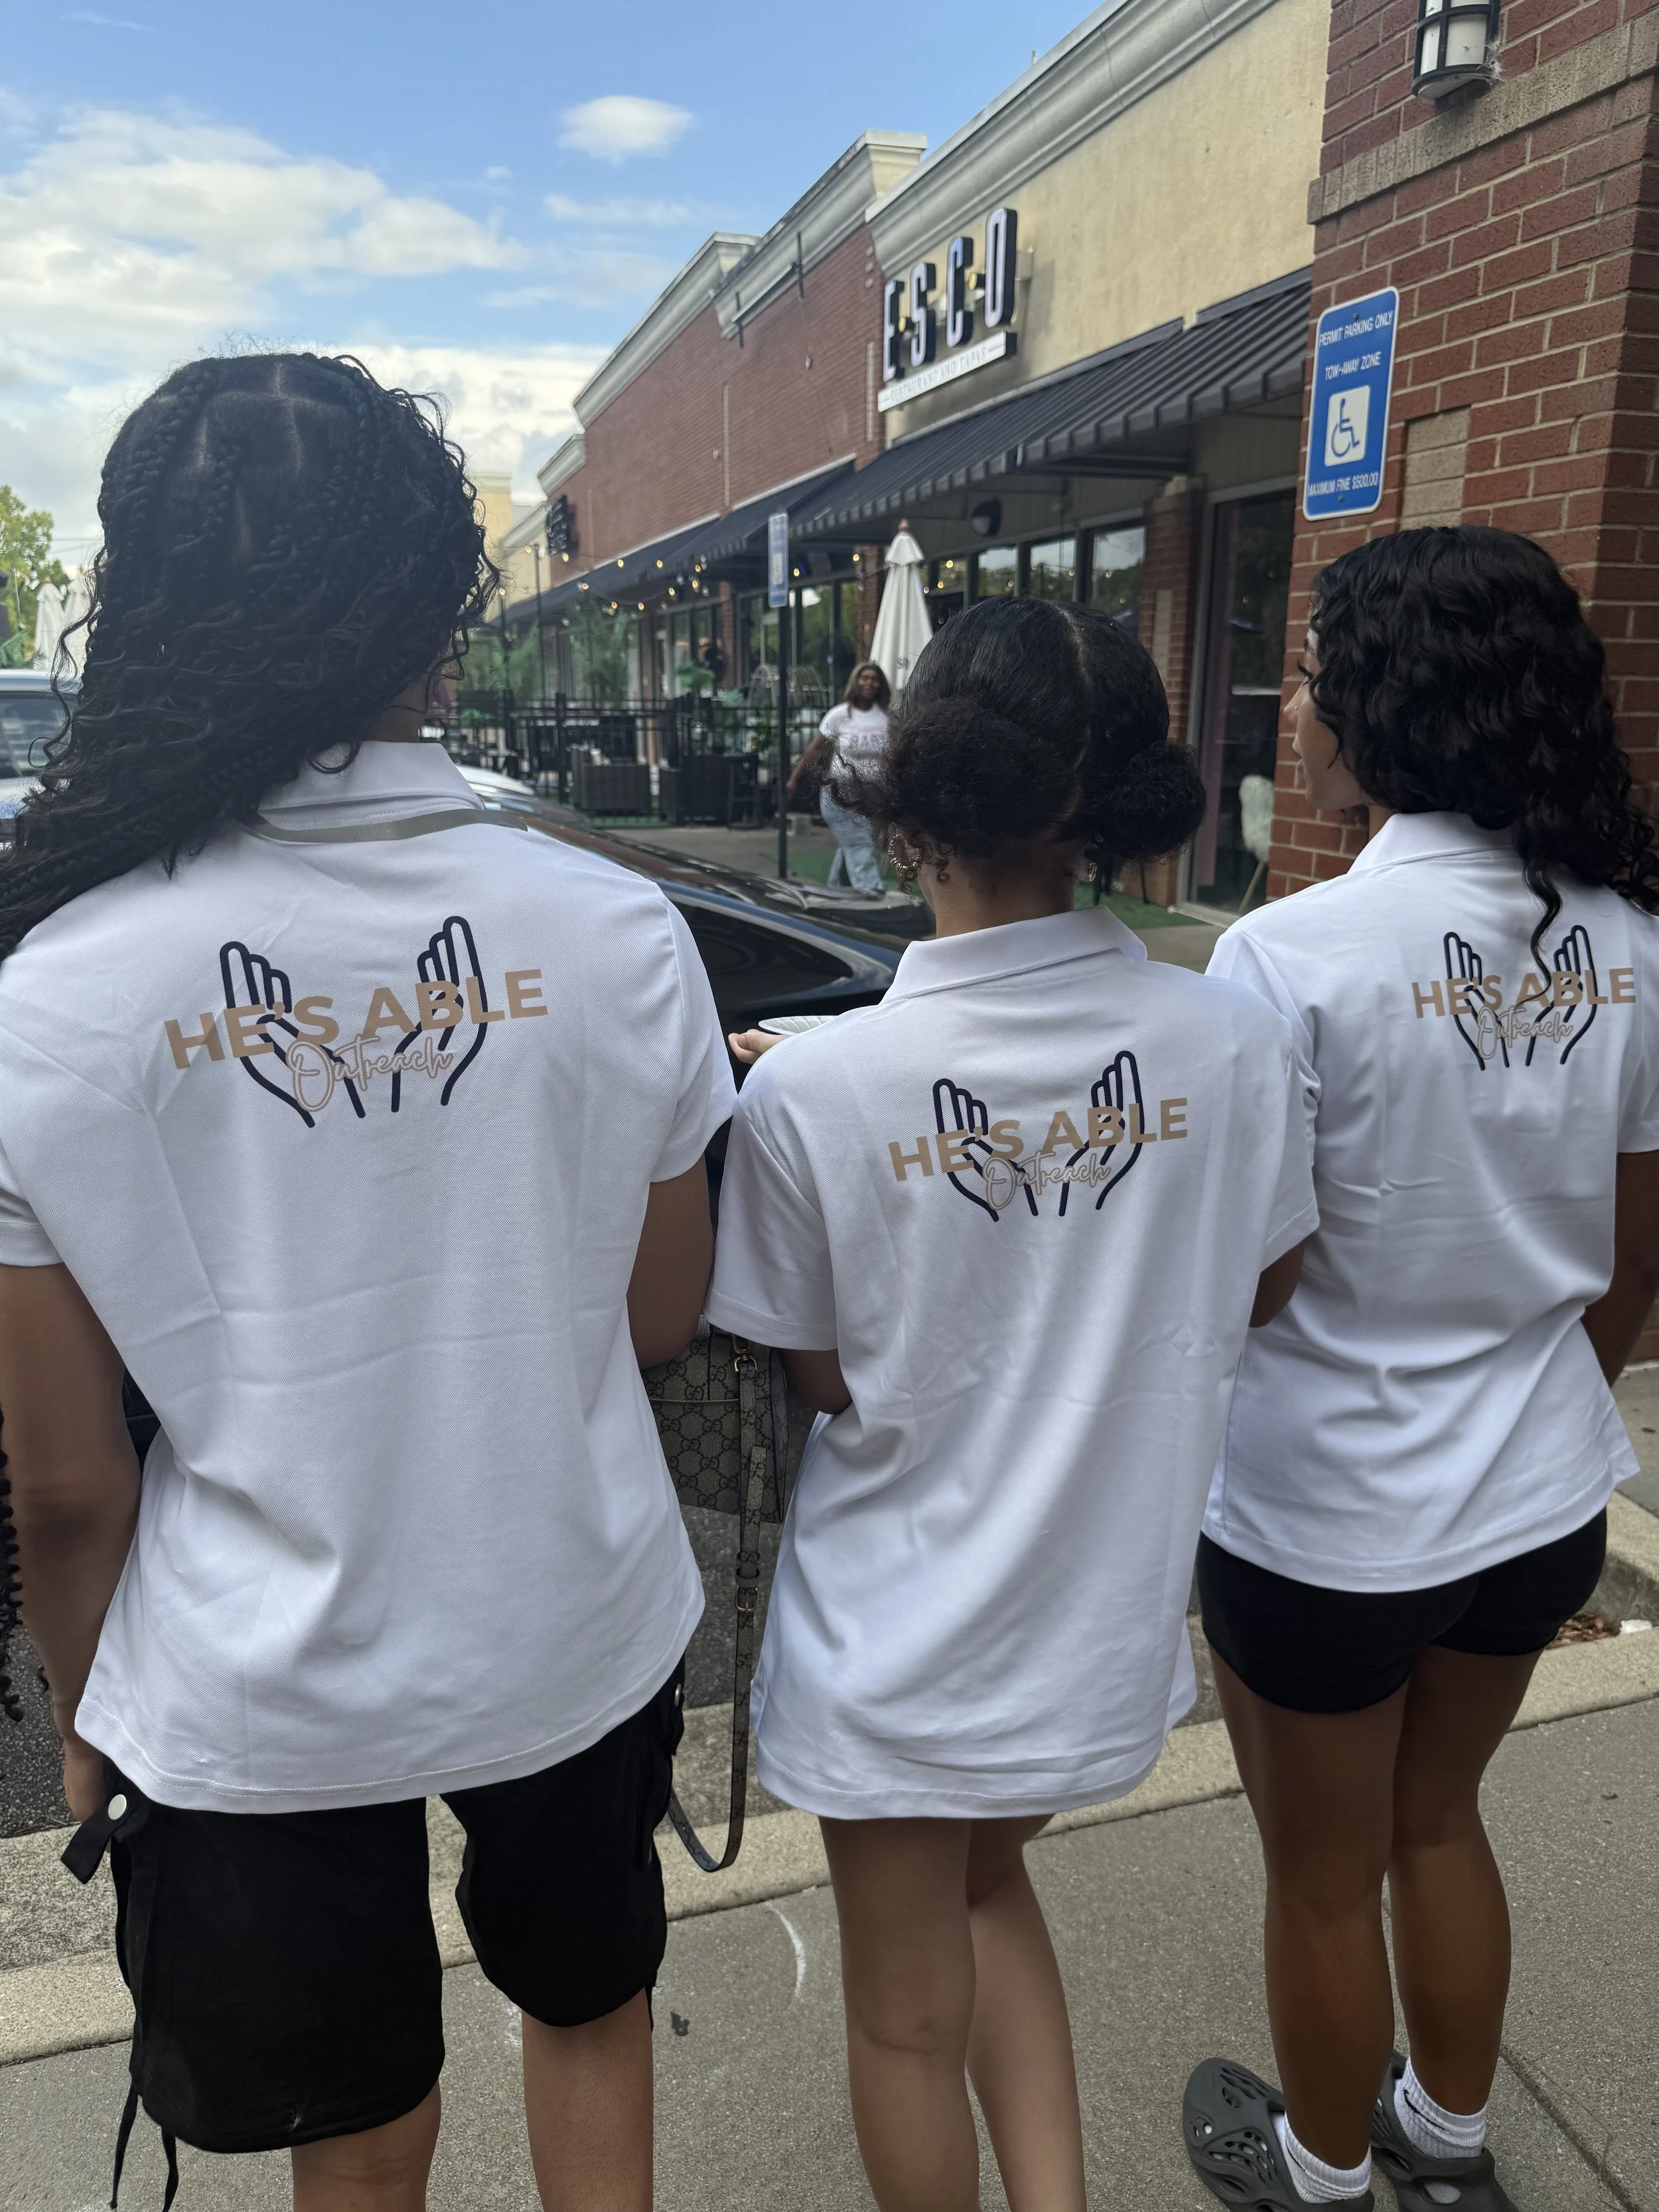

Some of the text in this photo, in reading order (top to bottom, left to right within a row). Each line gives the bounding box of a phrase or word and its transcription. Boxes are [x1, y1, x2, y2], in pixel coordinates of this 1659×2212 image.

[1319, 310, 1393, 347] PERMIT PARKING ONLY
[1325, 351, 1382, 380] TOW-AWAY ZONE
[1308, 479, 1335, 497] MAXIMUM
[1336, 477, 1350, 492] FINE
[164, 968, 548, 1070] HE'S ABLE
[1411, 968, 1636, 1019] HE'S ABLE
[1477, 1005, 1573, 1060] Outreach
[285, 1033, 453, 1112] Outreach
[887, 1097, 1188, 1181] HE'S ABLE
[981, 1149, 1112, 1211] Outreach
